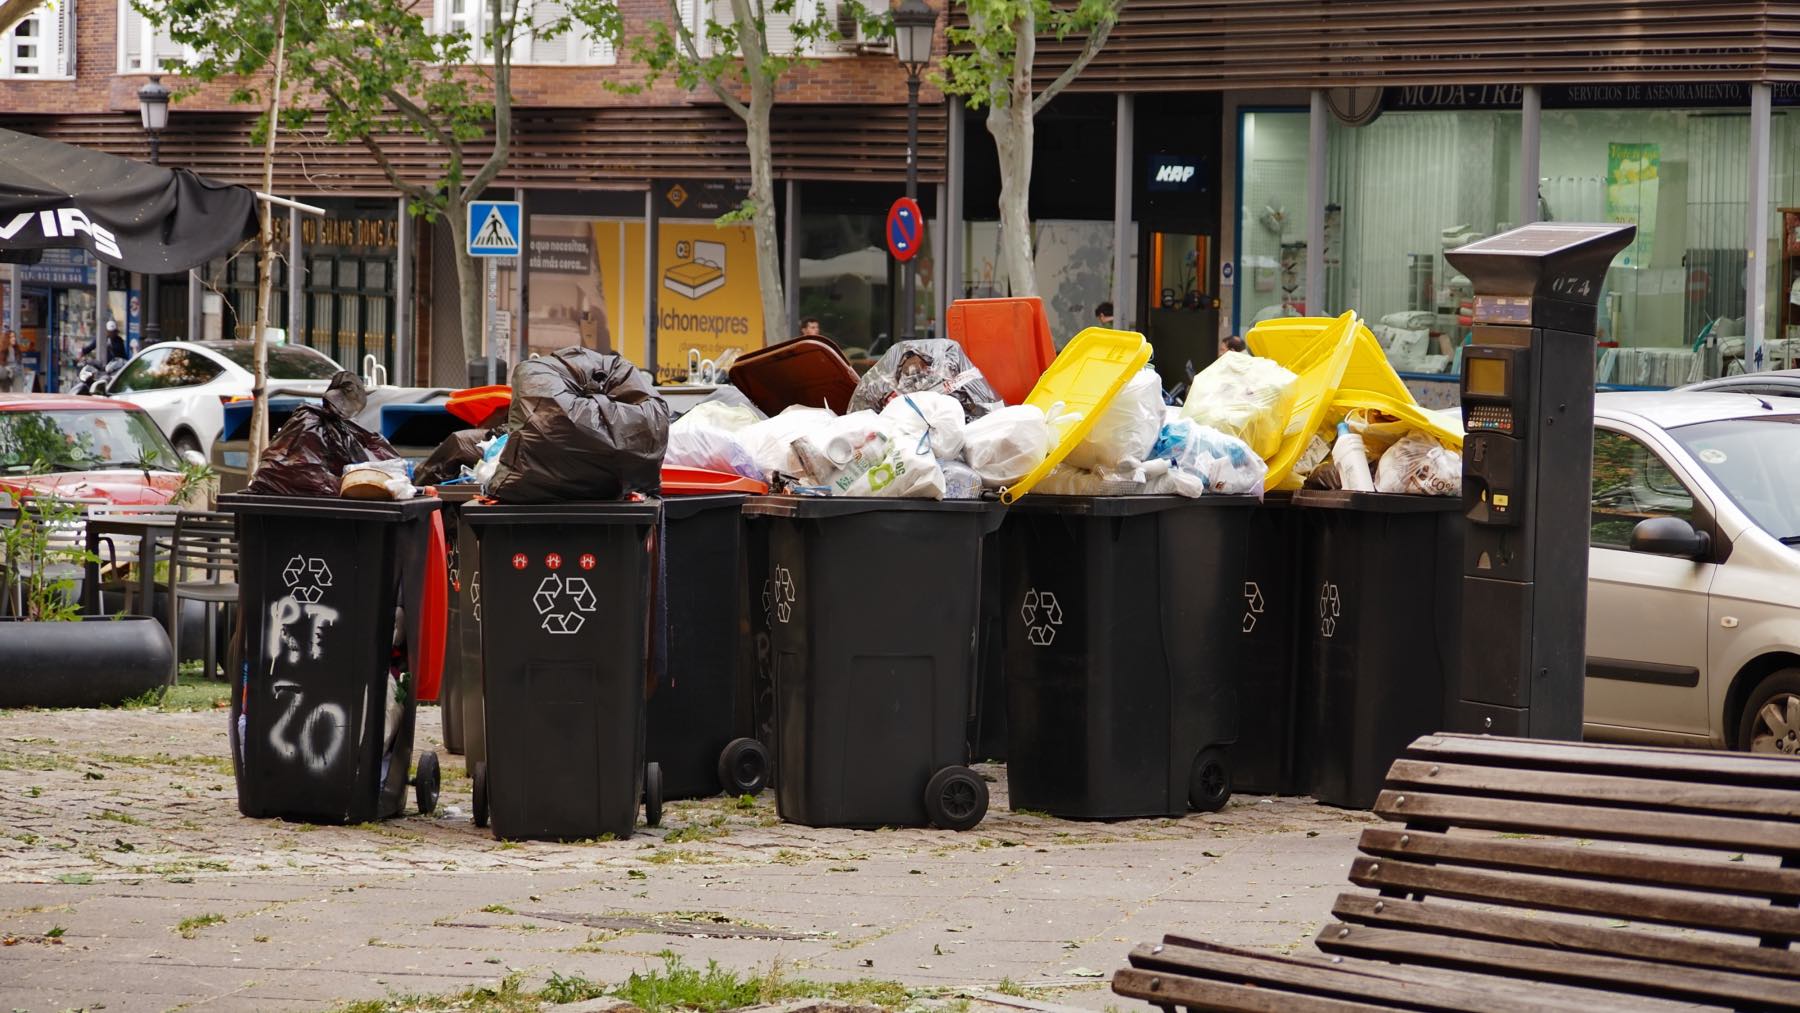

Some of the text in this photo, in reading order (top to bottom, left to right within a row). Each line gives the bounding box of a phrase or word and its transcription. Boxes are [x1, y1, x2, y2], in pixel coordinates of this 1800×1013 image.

[1568, 85, 1623, 102] SERVICIOS
[1627, 86, 1641, 101] DE
[1646, 83, 1742, 101] ASESORAMIENTO,
[0, 207, 123, 259] VIPS
[529, 256, 541, 268] stá
[1552, 277, 1591, 296] 074
[656, 307, 749, 338] lchonexpres
